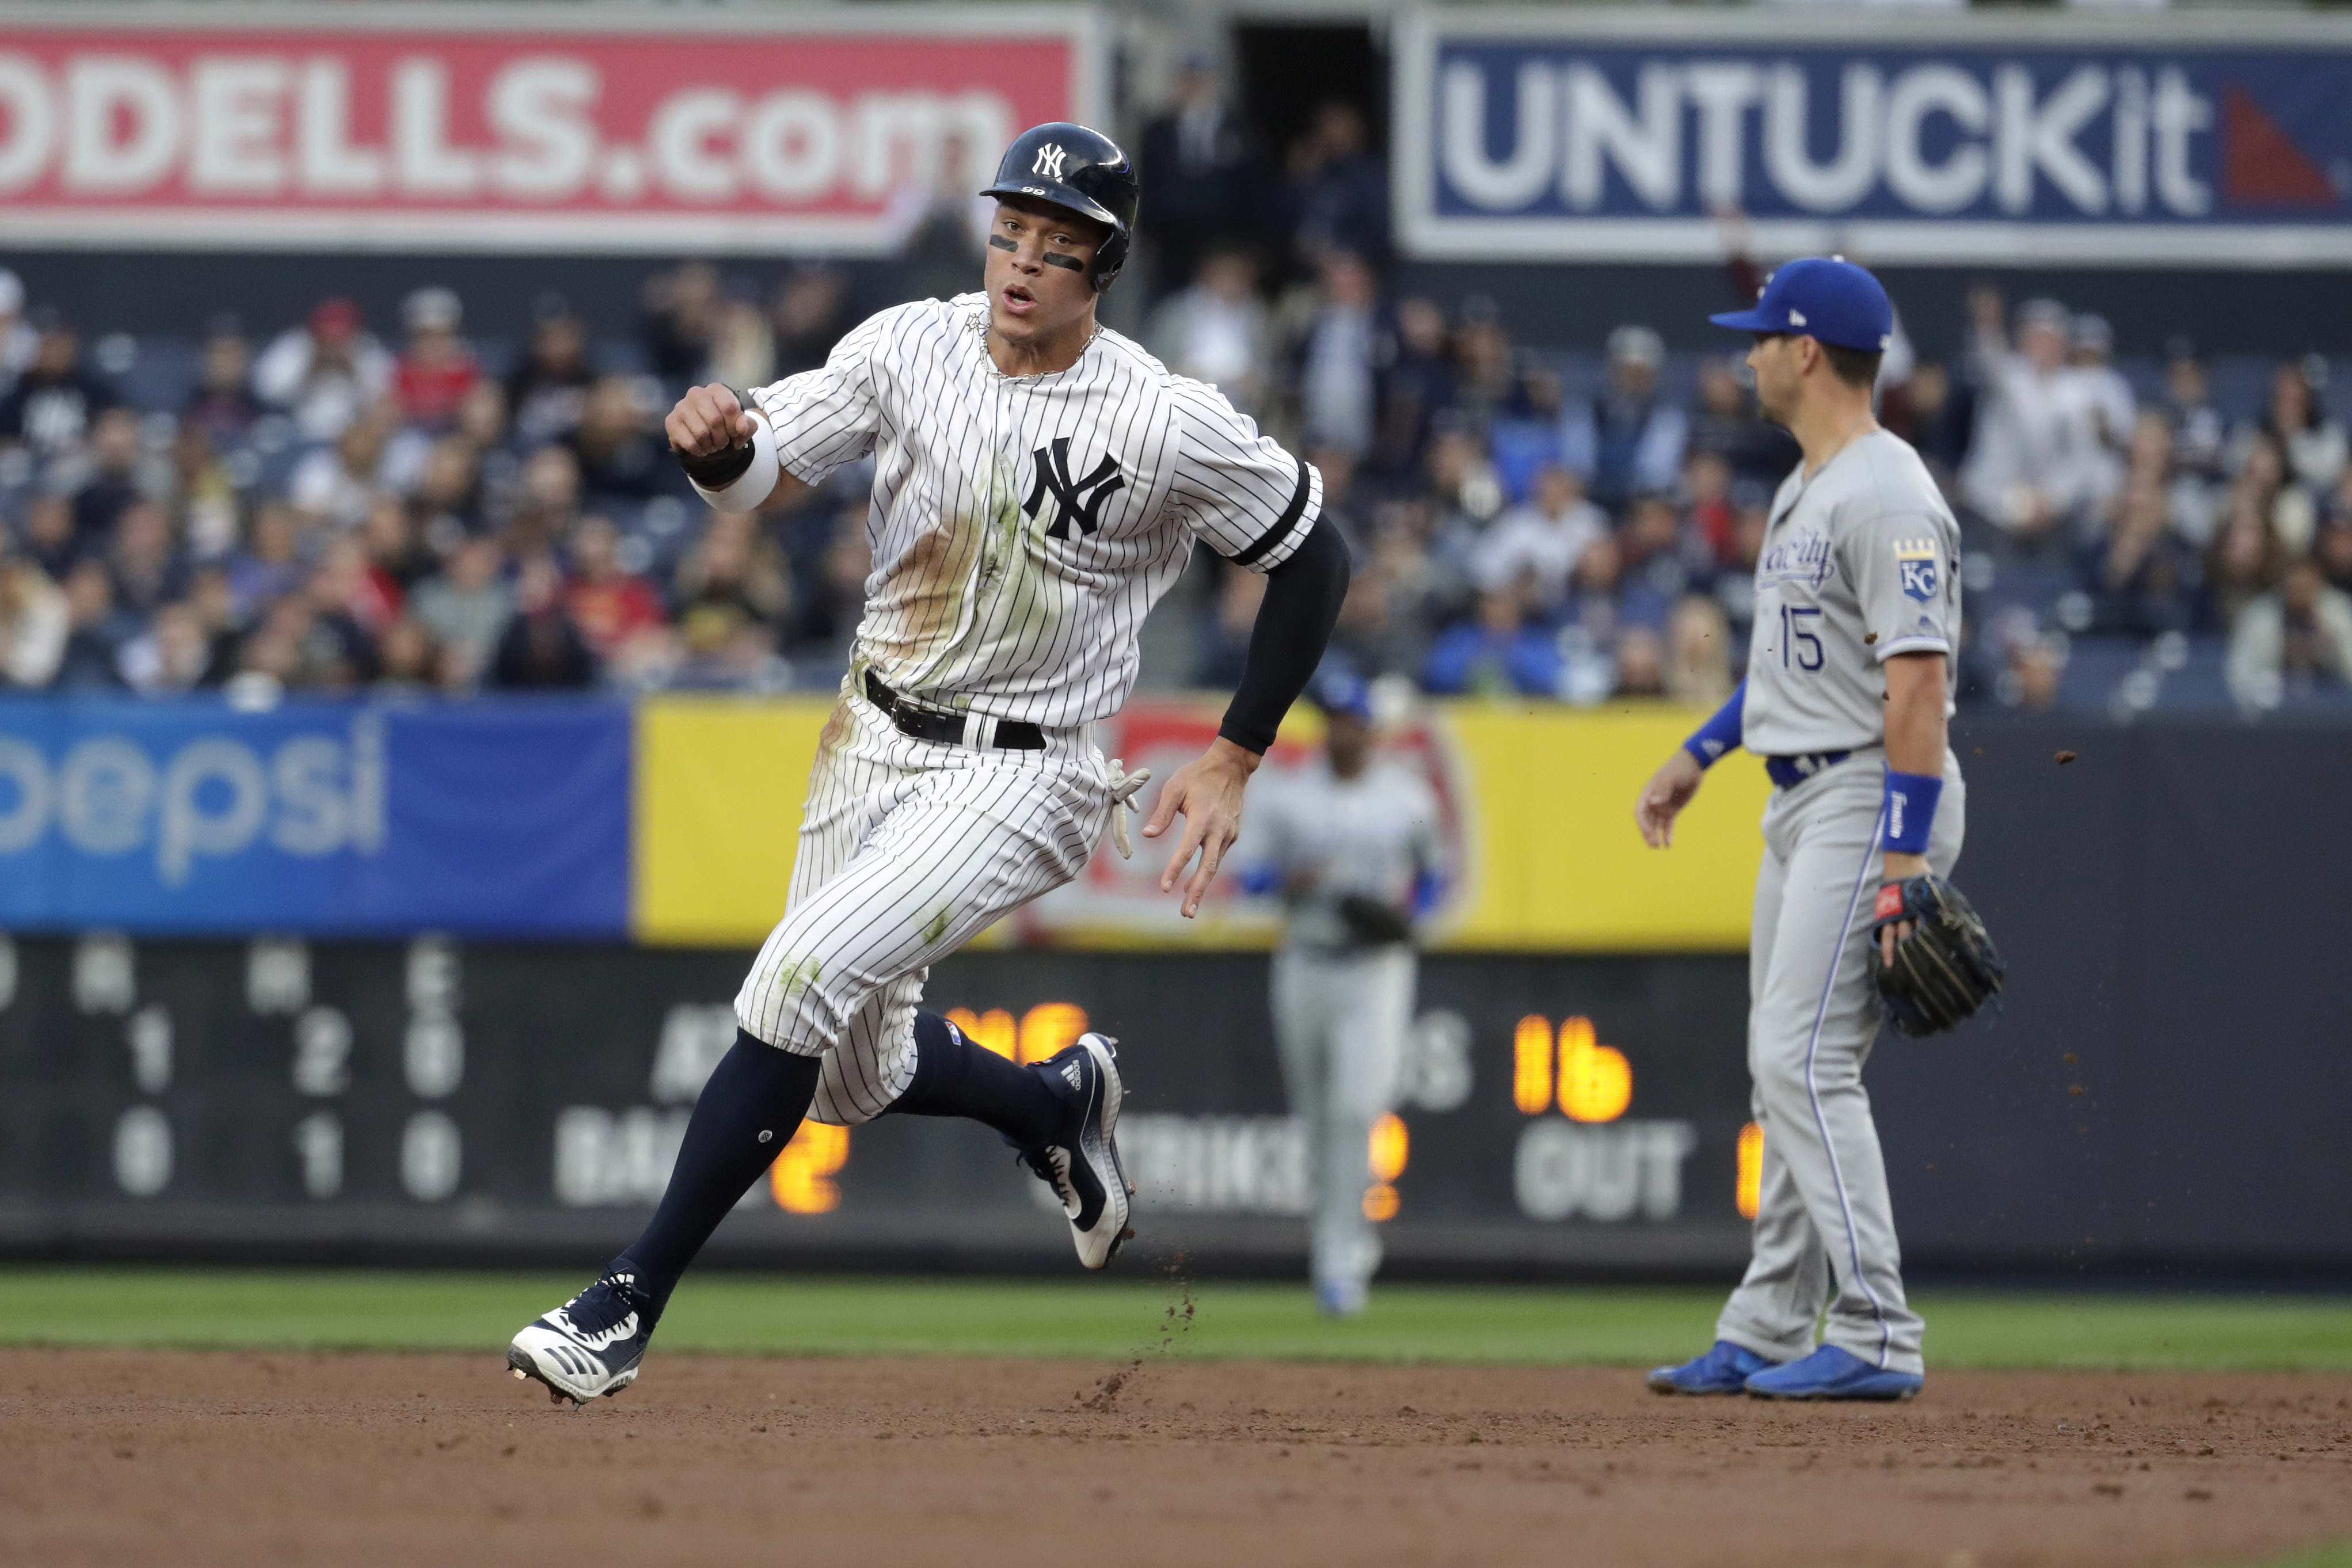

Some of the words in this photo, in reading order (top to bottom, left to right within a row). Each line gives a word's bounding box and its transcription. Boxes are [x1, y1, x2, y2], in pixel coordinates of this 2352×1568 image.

[1032, 143, 1067, 178] NY
[1442, 62, 2210, 214] UNTUCKit
[1021, 186, 1045, 196] 99
[1022, 437, 1125, 541] NY
[1901, 562, 1937, 597] KC
[1781, 604, 1824, 671] 15
[1072, 1059, 1082, 1091] adidas
[1513, 1014, 1634, 1124] 16
[1515, 1120, 1695, 1220] OUT
